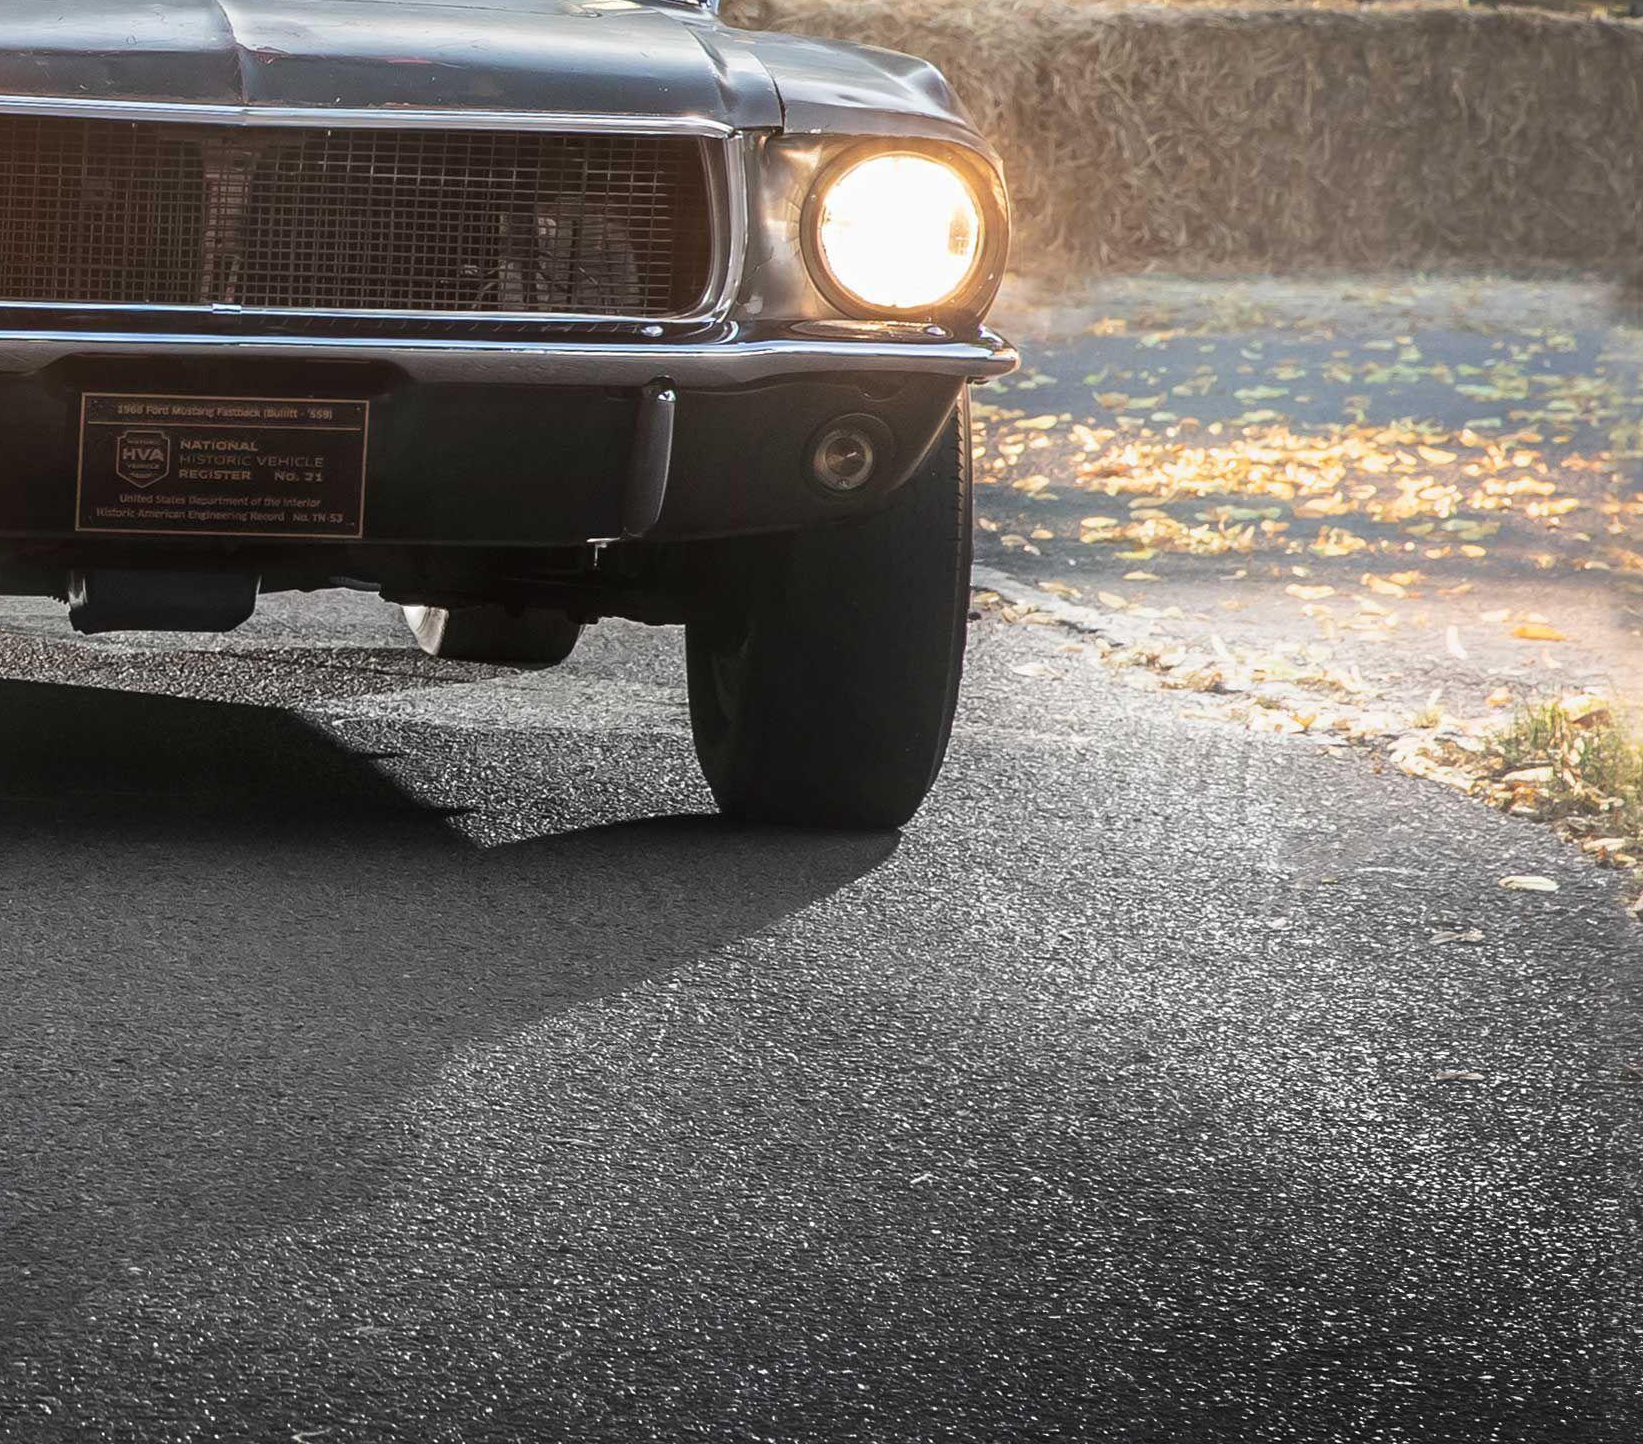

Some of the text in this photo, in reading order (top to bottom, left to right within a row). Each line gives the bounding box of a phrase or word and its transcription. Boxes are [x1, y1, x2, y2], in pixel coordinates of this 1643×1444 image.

[146, 404, 169, 416] Ford
[171, 405, 214, 418] Mustang
[217, 406, 261, 418] Fastback
[180, 439, 259, 452] NATIONAL
[122, 447, 164, 461] HVA
[179, 454, 324, 468] HISTORIC VEHICLE
[178, 469, 251, 481] REGISTER
[274, 471, 299, 482] No.
[119, 493, 321, 508] United States Department of the Interior
[96, 507, 135, 518] Historic
[137, 508, 185, 519] American
[187, 509, 248, 522] Engineering
[249, 510, 285, 522] Record
